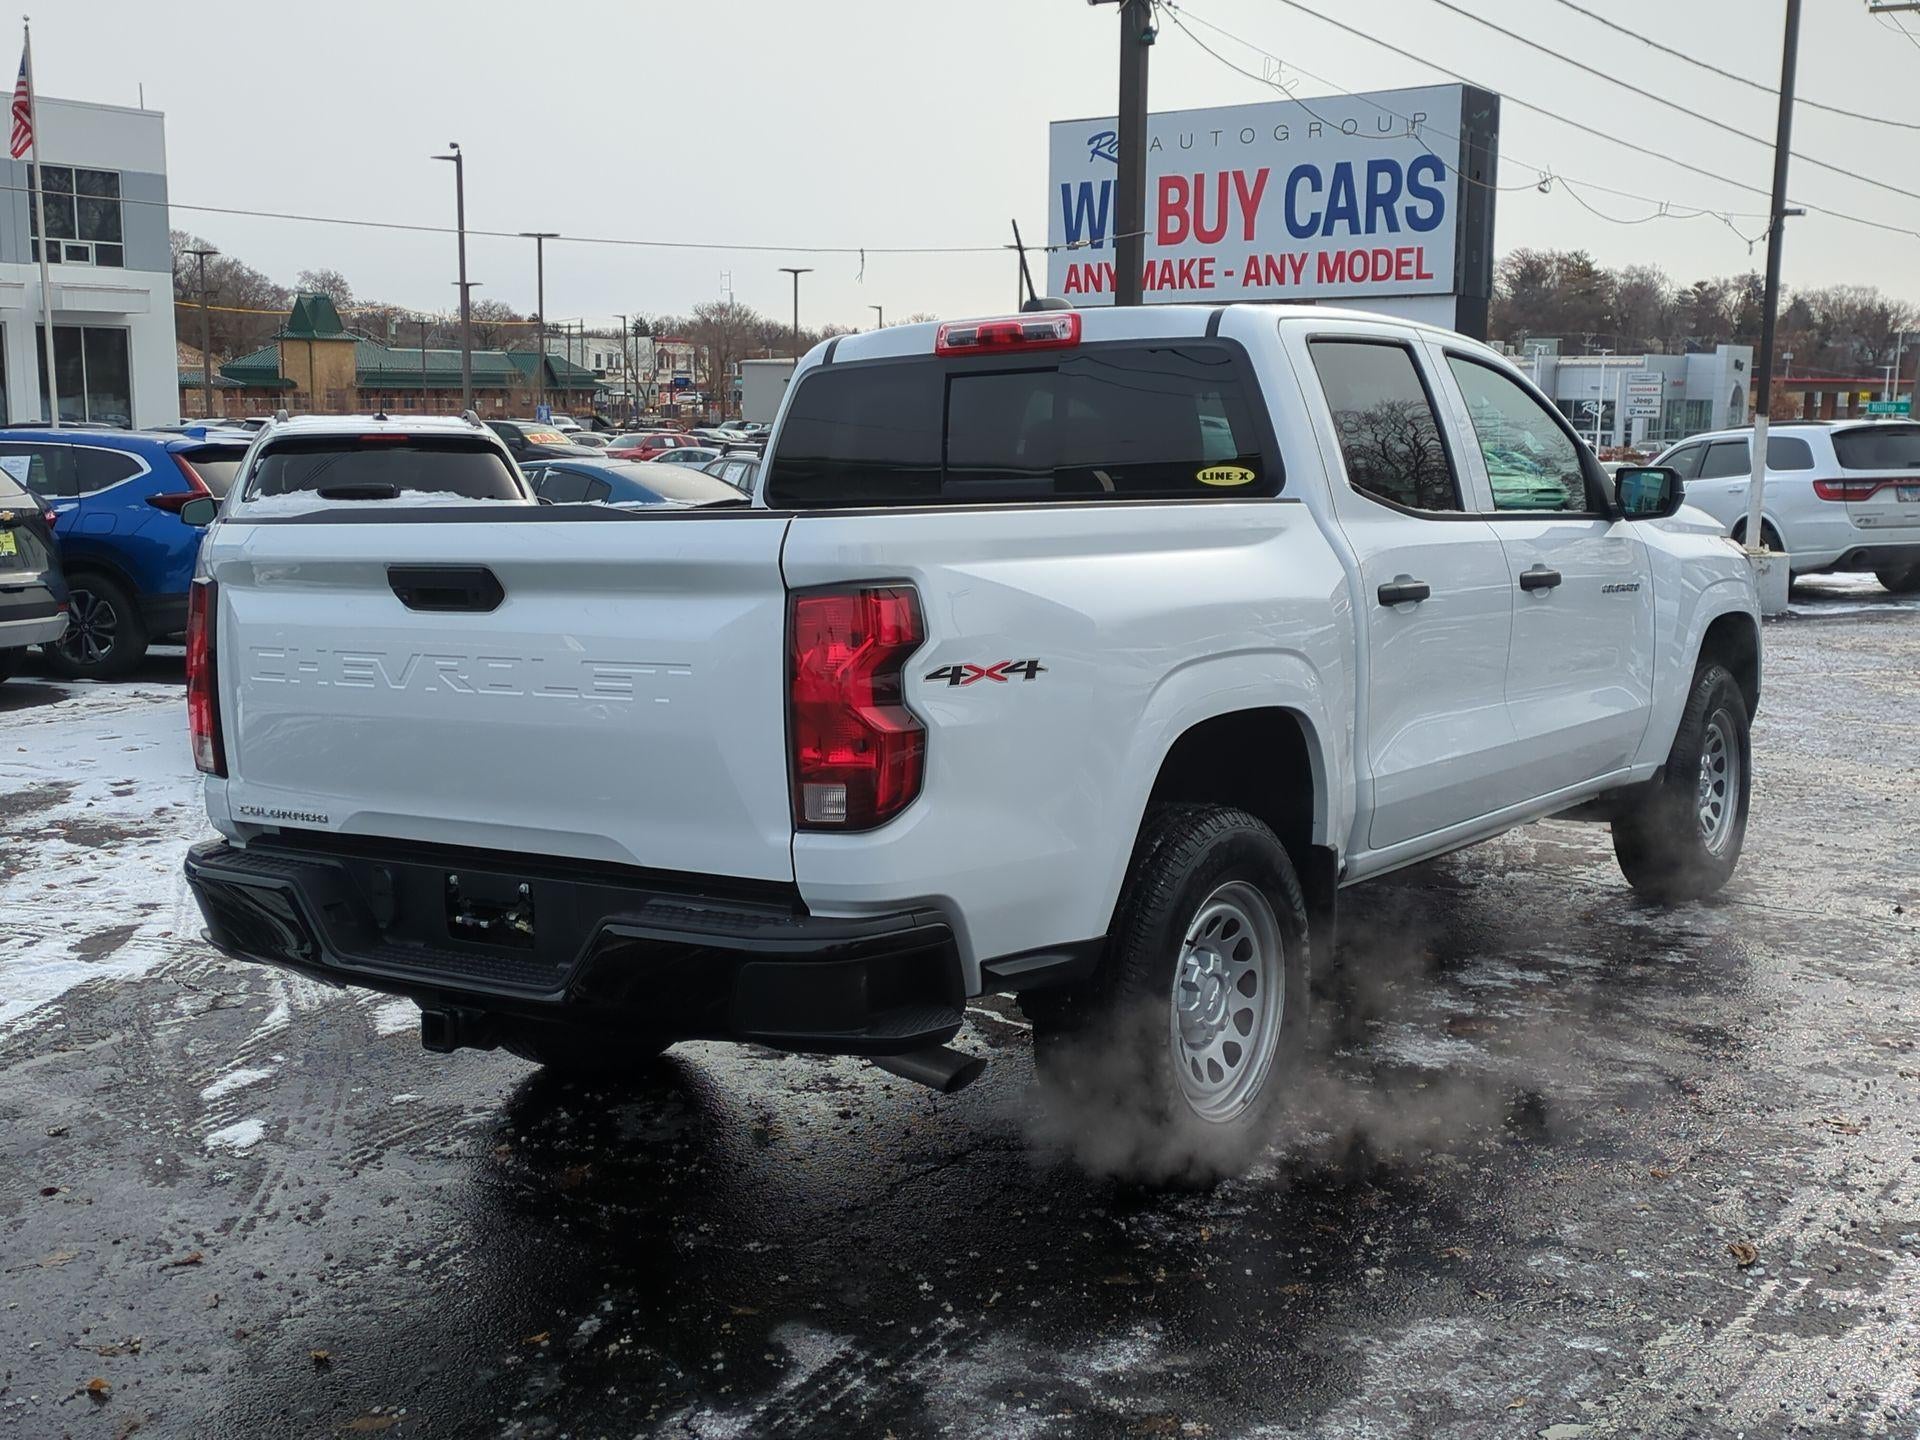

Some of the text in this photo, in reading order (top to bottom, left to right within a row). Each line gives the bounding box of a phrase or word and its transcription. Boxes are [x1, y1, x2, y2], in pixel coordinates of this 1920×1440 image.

[1150, 112, 1428, 152] AUTOGROUP
[1157, 167, 1270, 246] BUY
[1284, 154, 1446, 240] CARS
[1242, 252, 1308, 287] ANY
[1316, 246, 1434, 283] MODEL
[1202, 472, 1248, 480] LINE-X
[249, 646, 692, 702] CHEVROLET
